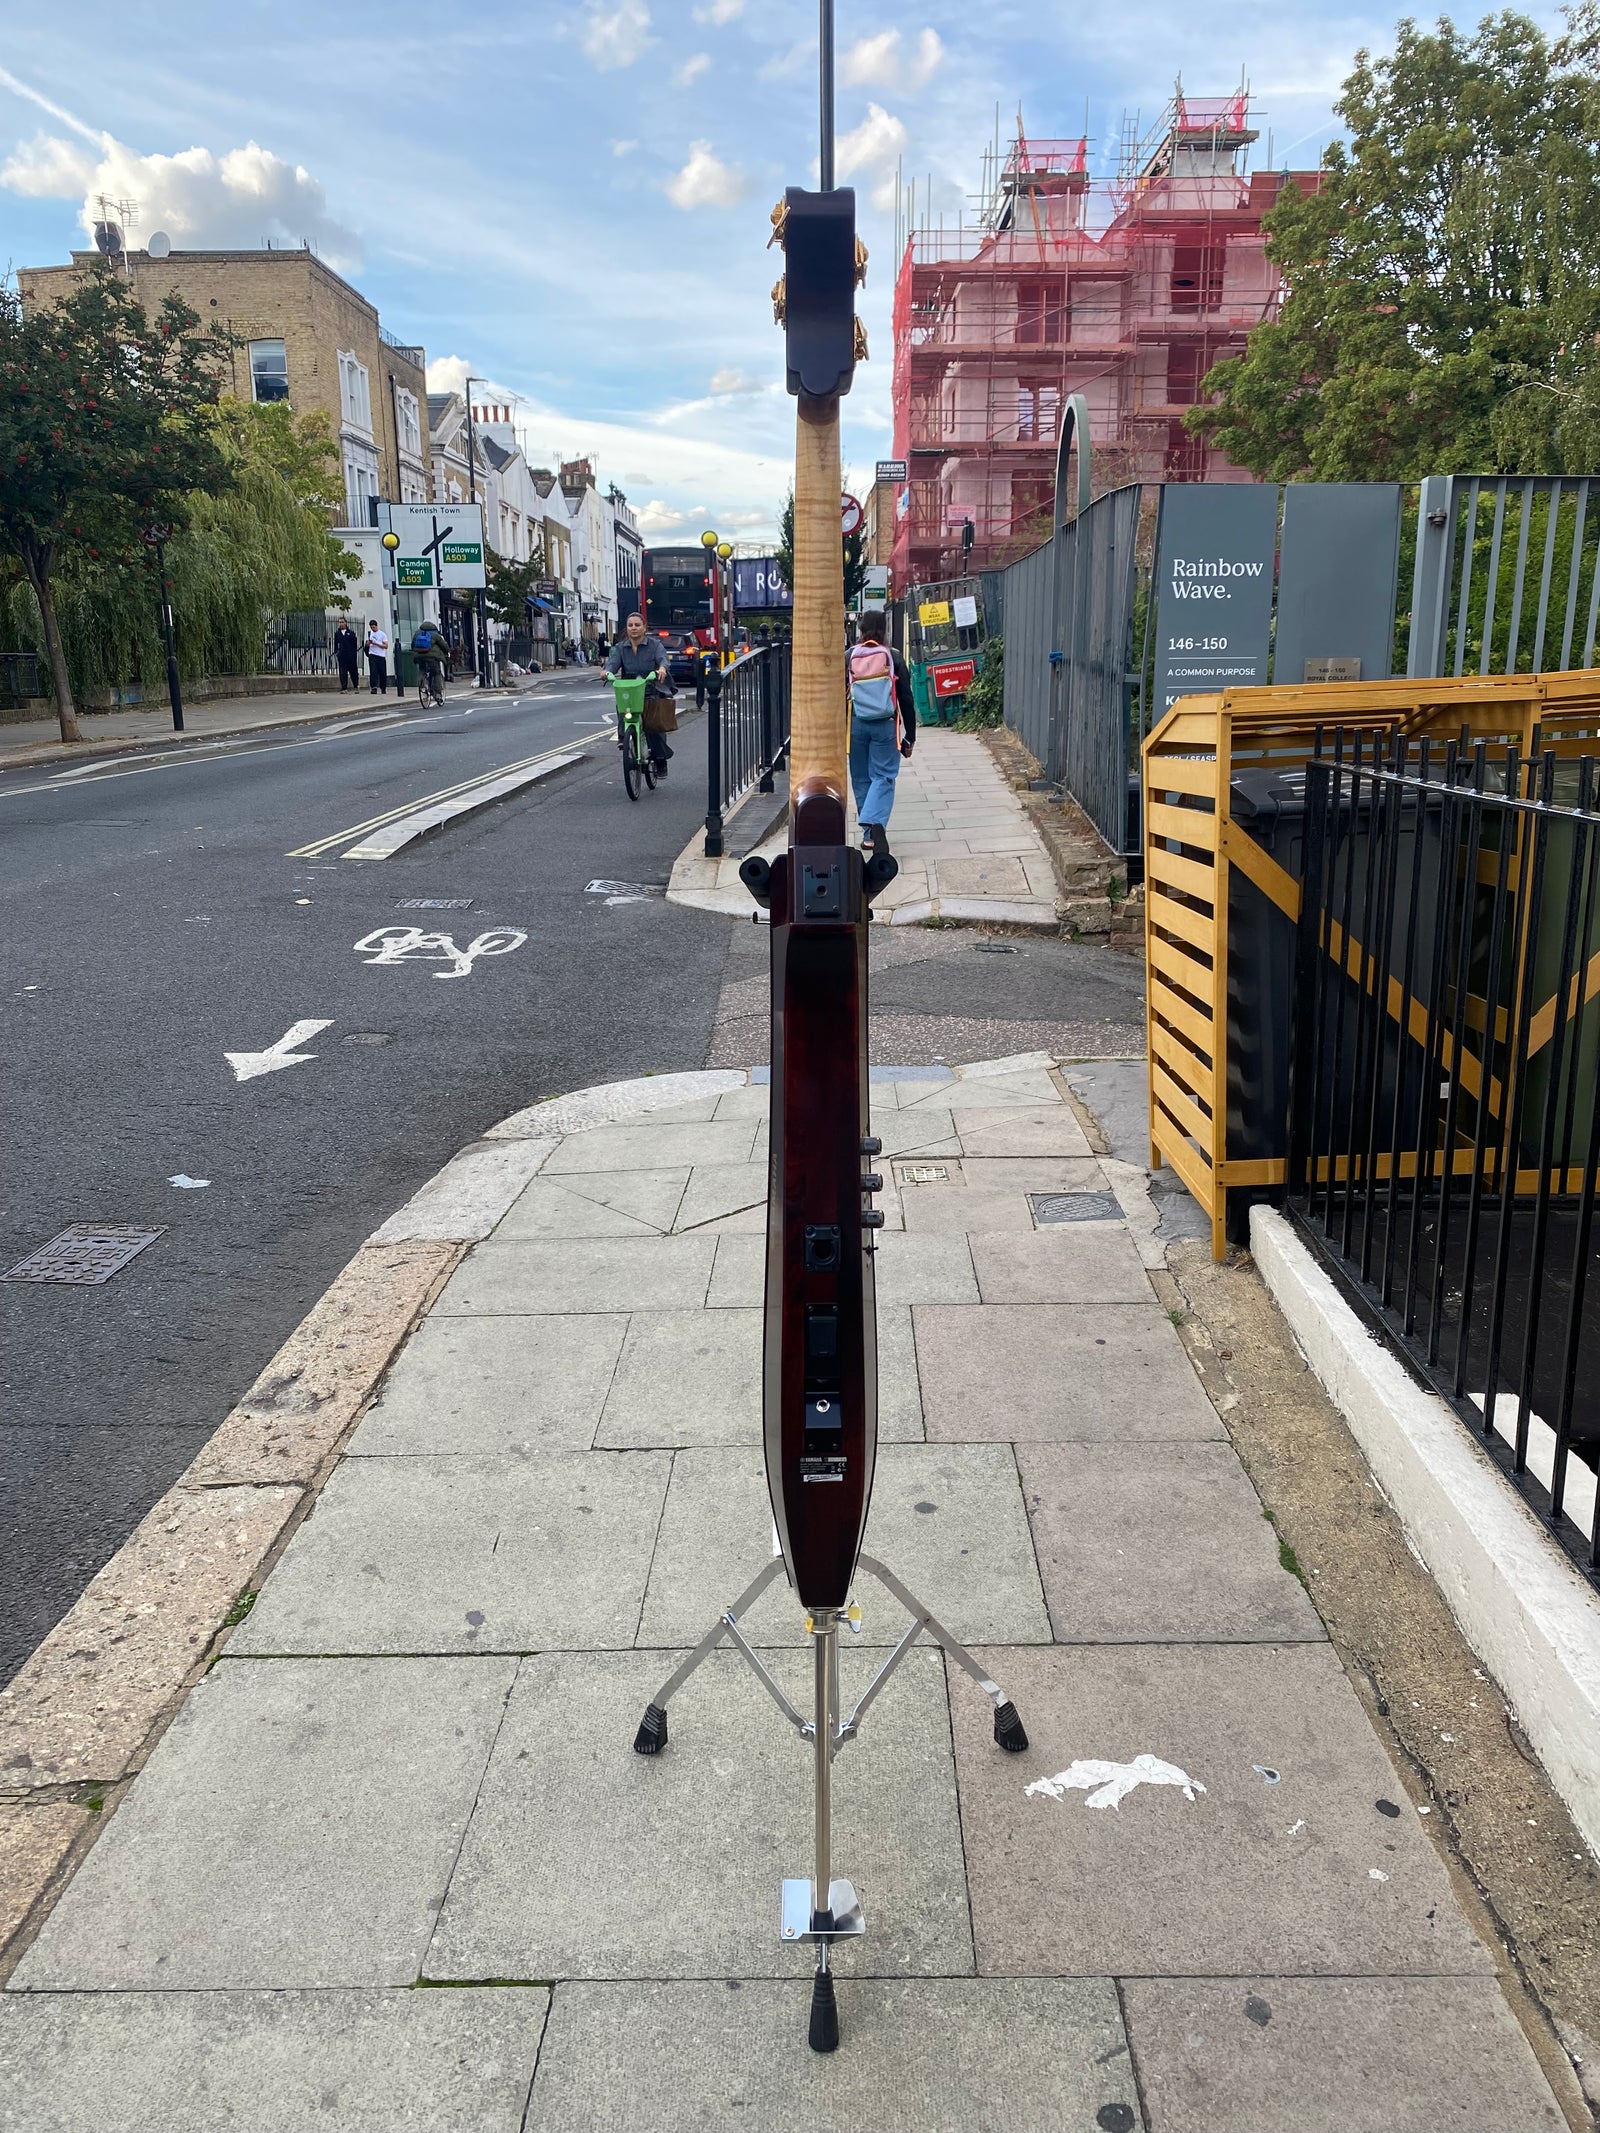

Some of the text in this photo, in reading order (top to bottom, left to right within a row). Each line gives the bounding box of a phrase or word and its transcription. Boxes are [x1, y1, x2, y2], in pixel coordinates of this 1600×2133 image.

[444, 546, 479, 554] Holloway
[405, 568, 425, 576] Town
[1173, 558, 1264, 577] Rainbow
[673, 577, 685, 588] 274
[1171, 581, 1232, 599] Wave.
[1168, 637, 1228, 650] 146-150
[935, 664, 972, 674] PEDESTRIANS
[1167, 667, 1256, 676] A COMMON PURPOSE
[40, 1245, 132, 1259] METER
